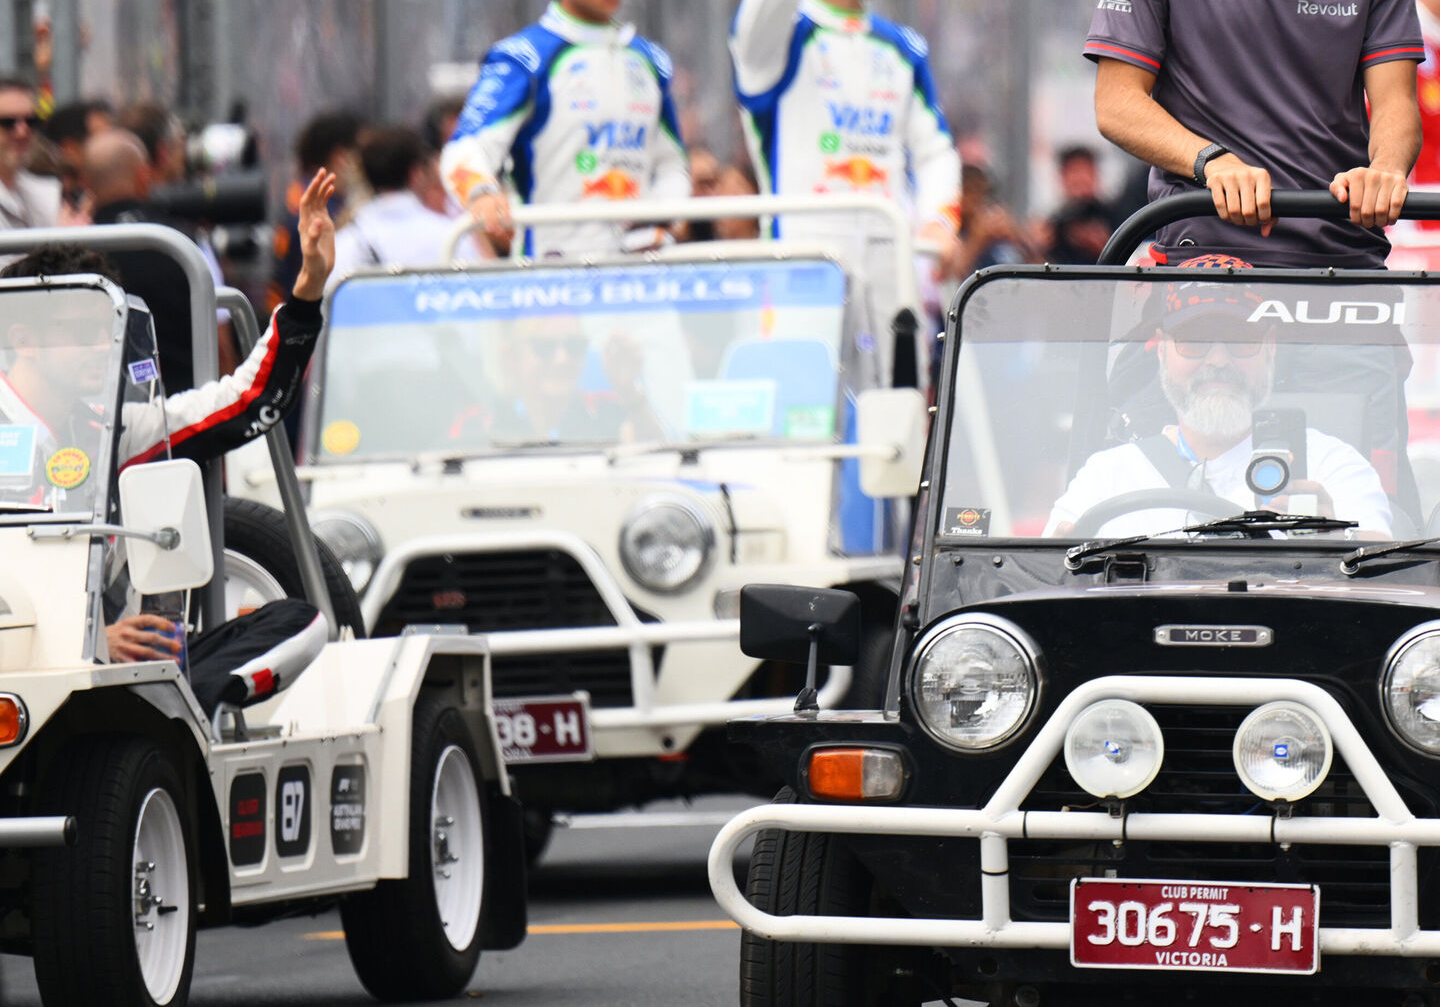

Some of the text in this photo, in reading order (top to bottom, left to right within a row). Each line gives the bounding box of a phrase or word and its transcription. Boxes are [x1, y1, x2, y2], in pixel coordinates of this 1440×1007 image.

[1297, 0, 1358, 17] Revolut
[414, 279, 754, 313] RACING BULLS
[1246, 299, 1407, 325] AUDI
[951, 527, 983, 535] Thanks
[1185, 630, 1242, 641] MOKE
[552, 709, 582, 746] H
[282, 781, 304, 842] 87
[1161, 885, 1229, 901] CLUB PERMIT
[1155, 951, 1228, 967] VICTORIA
